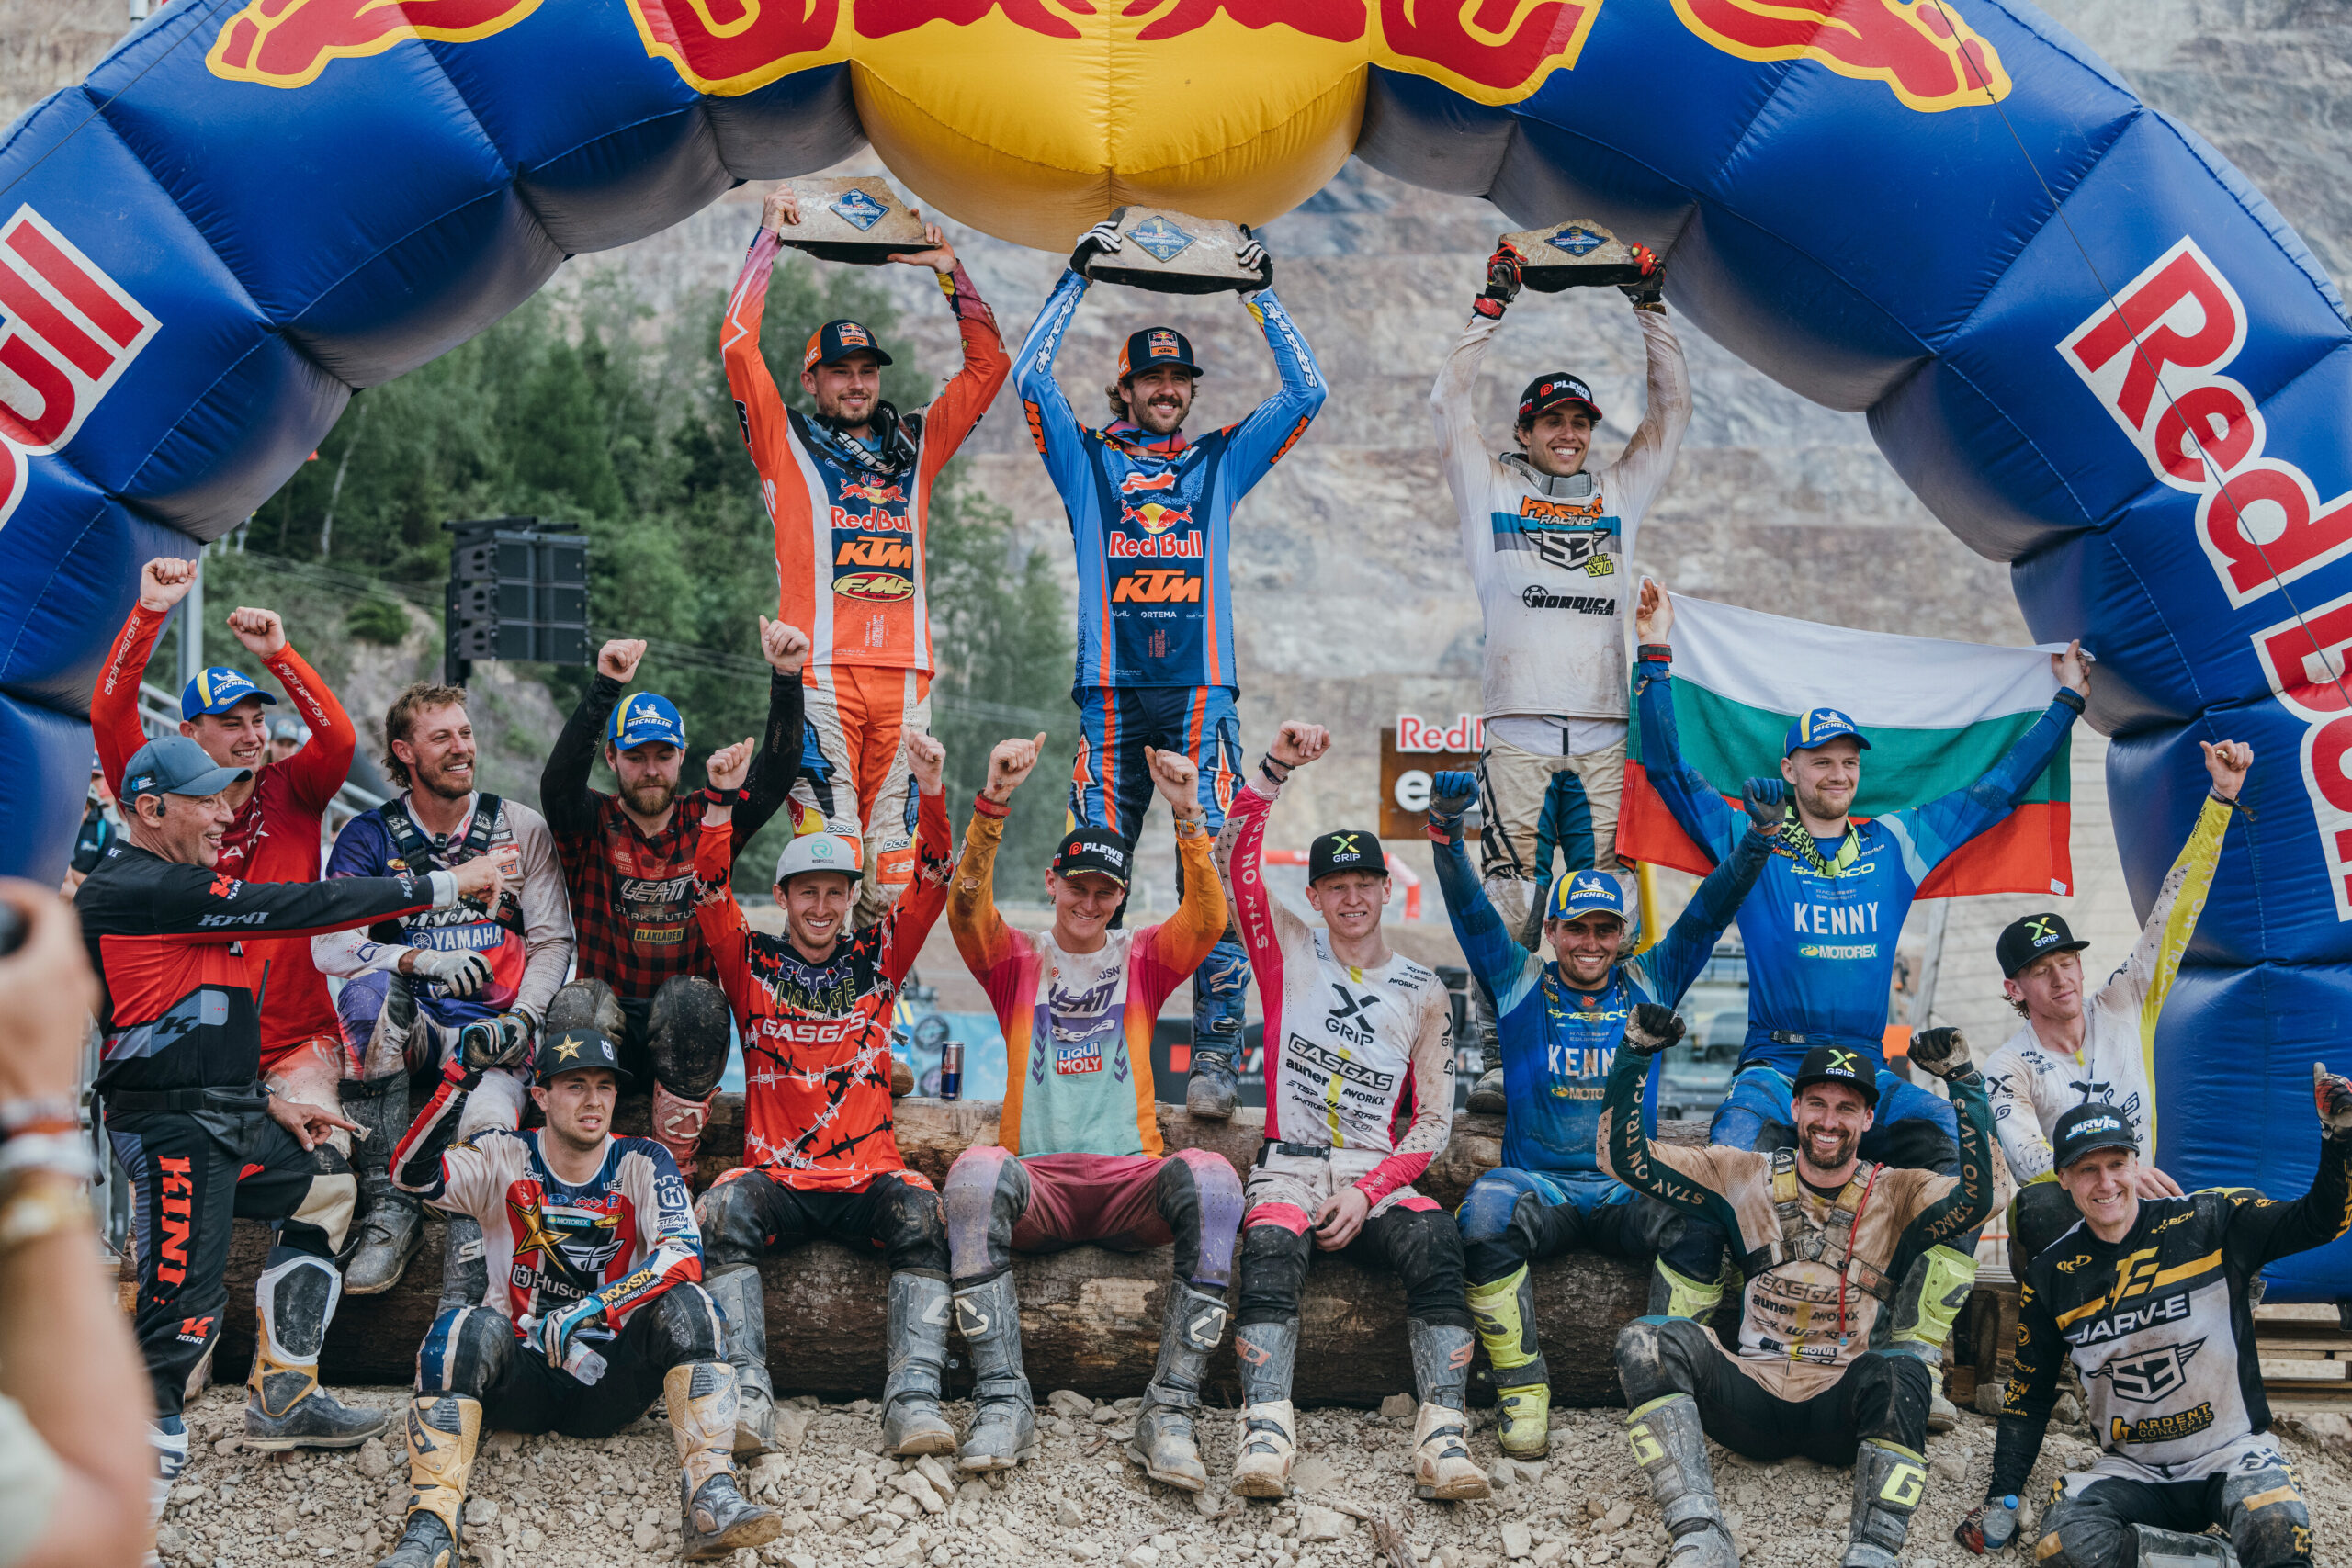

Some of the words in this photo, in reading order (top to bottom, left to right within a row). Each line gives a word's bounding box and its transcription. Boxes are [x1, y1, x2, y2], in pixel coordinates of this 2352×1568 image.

[850, 191, 863, 205] 2
[1152, 219, 1163, 233] 1
[1263, 299, 1317, 389] alpinestars
[0, 217, 147, 516] ull
[1553, 379, 1590, 398] PLEWS
[2072, 250, 2352, 594] Red
[831, 506, 876, 532] Red
[1539, 514, 1593, 526] RACING
[835, 536, 913, 569] KTM
[1108, 530, 1158, 558] Red
[1159, 530, 1204, 558] Bull
[1587, 553, 1608, 564] SORRY
[832, 576, 914, 595] FMF
[1112, 569, 1202, 603] KTM
[104, 614, 141, 695] alpinestars
[214, 680, 255, 696] MICHELIN
[278, 662, 331, 727] alpinestars
[626, 718, 673, 728] MICHELIN
[1399, 716, 1467, 749] Red
[1813, 722, 1855, 733] MICHELIN
[883, 837, 911, 851] pod
[1082, 842, 1124, 861] PLEWS
[1333, 853, 1361, 863] GRIP
[1570, 891, 1616, 902] MICHELIN
[198, 911, 270, 927] KINI
[656, 908, 696, 921] FUTUR
[1793, 901, 1879, 935] KENNY
[433, 925, 503, 951] YAMAHA
[2033, 933, 2060, 947] GRIP
[1818, 944, 1877, 959] MOTOREX
[1325, 1017, 1374, 1046] GRIP
[1058, 1042, 1101, 1060] LIQUI
[1548, 1043, 1617, 1077] KENN
[1058, 1056, 1102, 1074] MOLY
[1286, 1058, 1330, 1087] auner
[1289, 1035, 1394, 1091] GASGAS
[1826, 1067, 1855, 1077] GRIP
[1569, 1087, 1606, 1100] MOTO
[1627, 1150, 1649, 1179] ON
[1963, 1163, 1978, 1200] ON
[1650, 1178, 1705, 1205] STAY
[157, 1155, 191, 1289] KINI
[557, 1217, 589, 1227] MOTOREX
[661, 1213, 690, 1225] TEAM
[1924, 1201, 1974, 1240] TRACK
[1757, 1272, 1861, 1304] GASGAS
[614, 1291, 641, 1309] ENERGY
[1752, 1294, 1797, 1316] auner
[2077, 1293, 2188, 1345] JARV-E
[175, 1333, 204, 1345] KINI
[1824, 1329, 1859, 1339] XTIG
[1799, 1347, 1836, 1356] MOTUL
[2139, 1404, 2209, 1429] ARDENT
[2139, 1413, 2213, 1438] CONCEPTS
